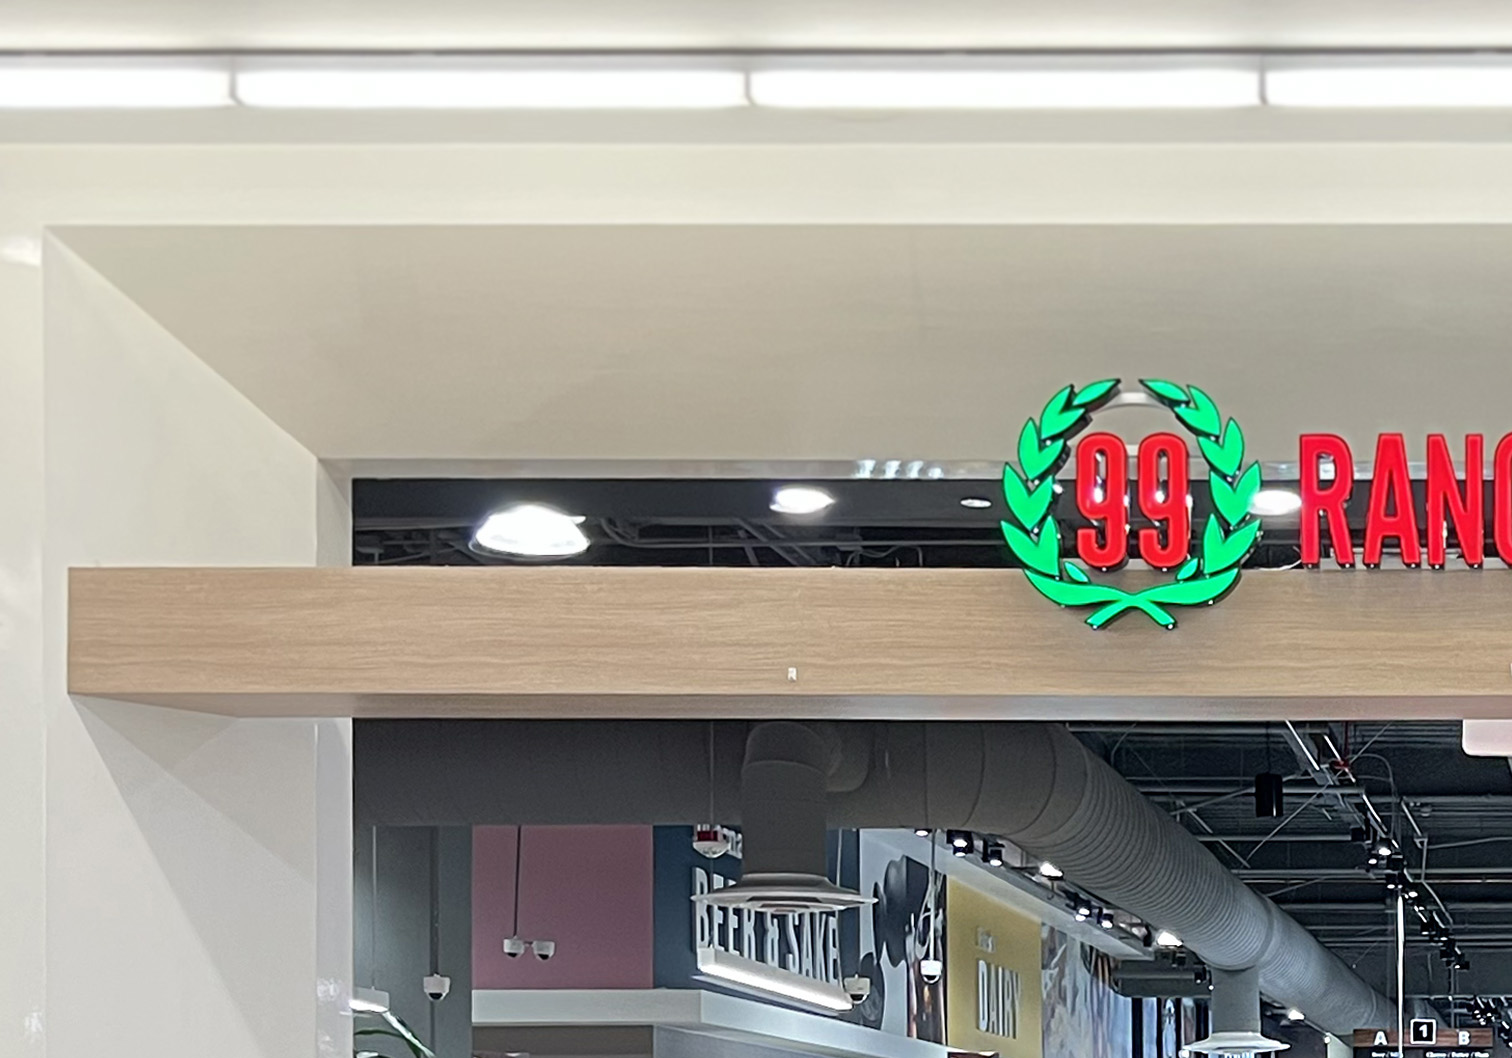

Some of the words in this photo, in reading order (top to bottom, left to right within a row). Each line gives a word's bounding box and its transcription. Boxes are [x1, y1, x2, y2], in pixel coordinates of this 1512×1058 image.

[1076, 432, 1191, 570] 99
[696, 867, 757, 962] BEER
[766, 911, 780, 969] &
[786, 909, 839, 985] SAKE
[977, 959, 1022, 1039] DAIRY
[1374, 1030, 1388, 1046] A
[1418, 1024, 1429, 1039] 1
[1458, 1031, 1471, 1046] B
